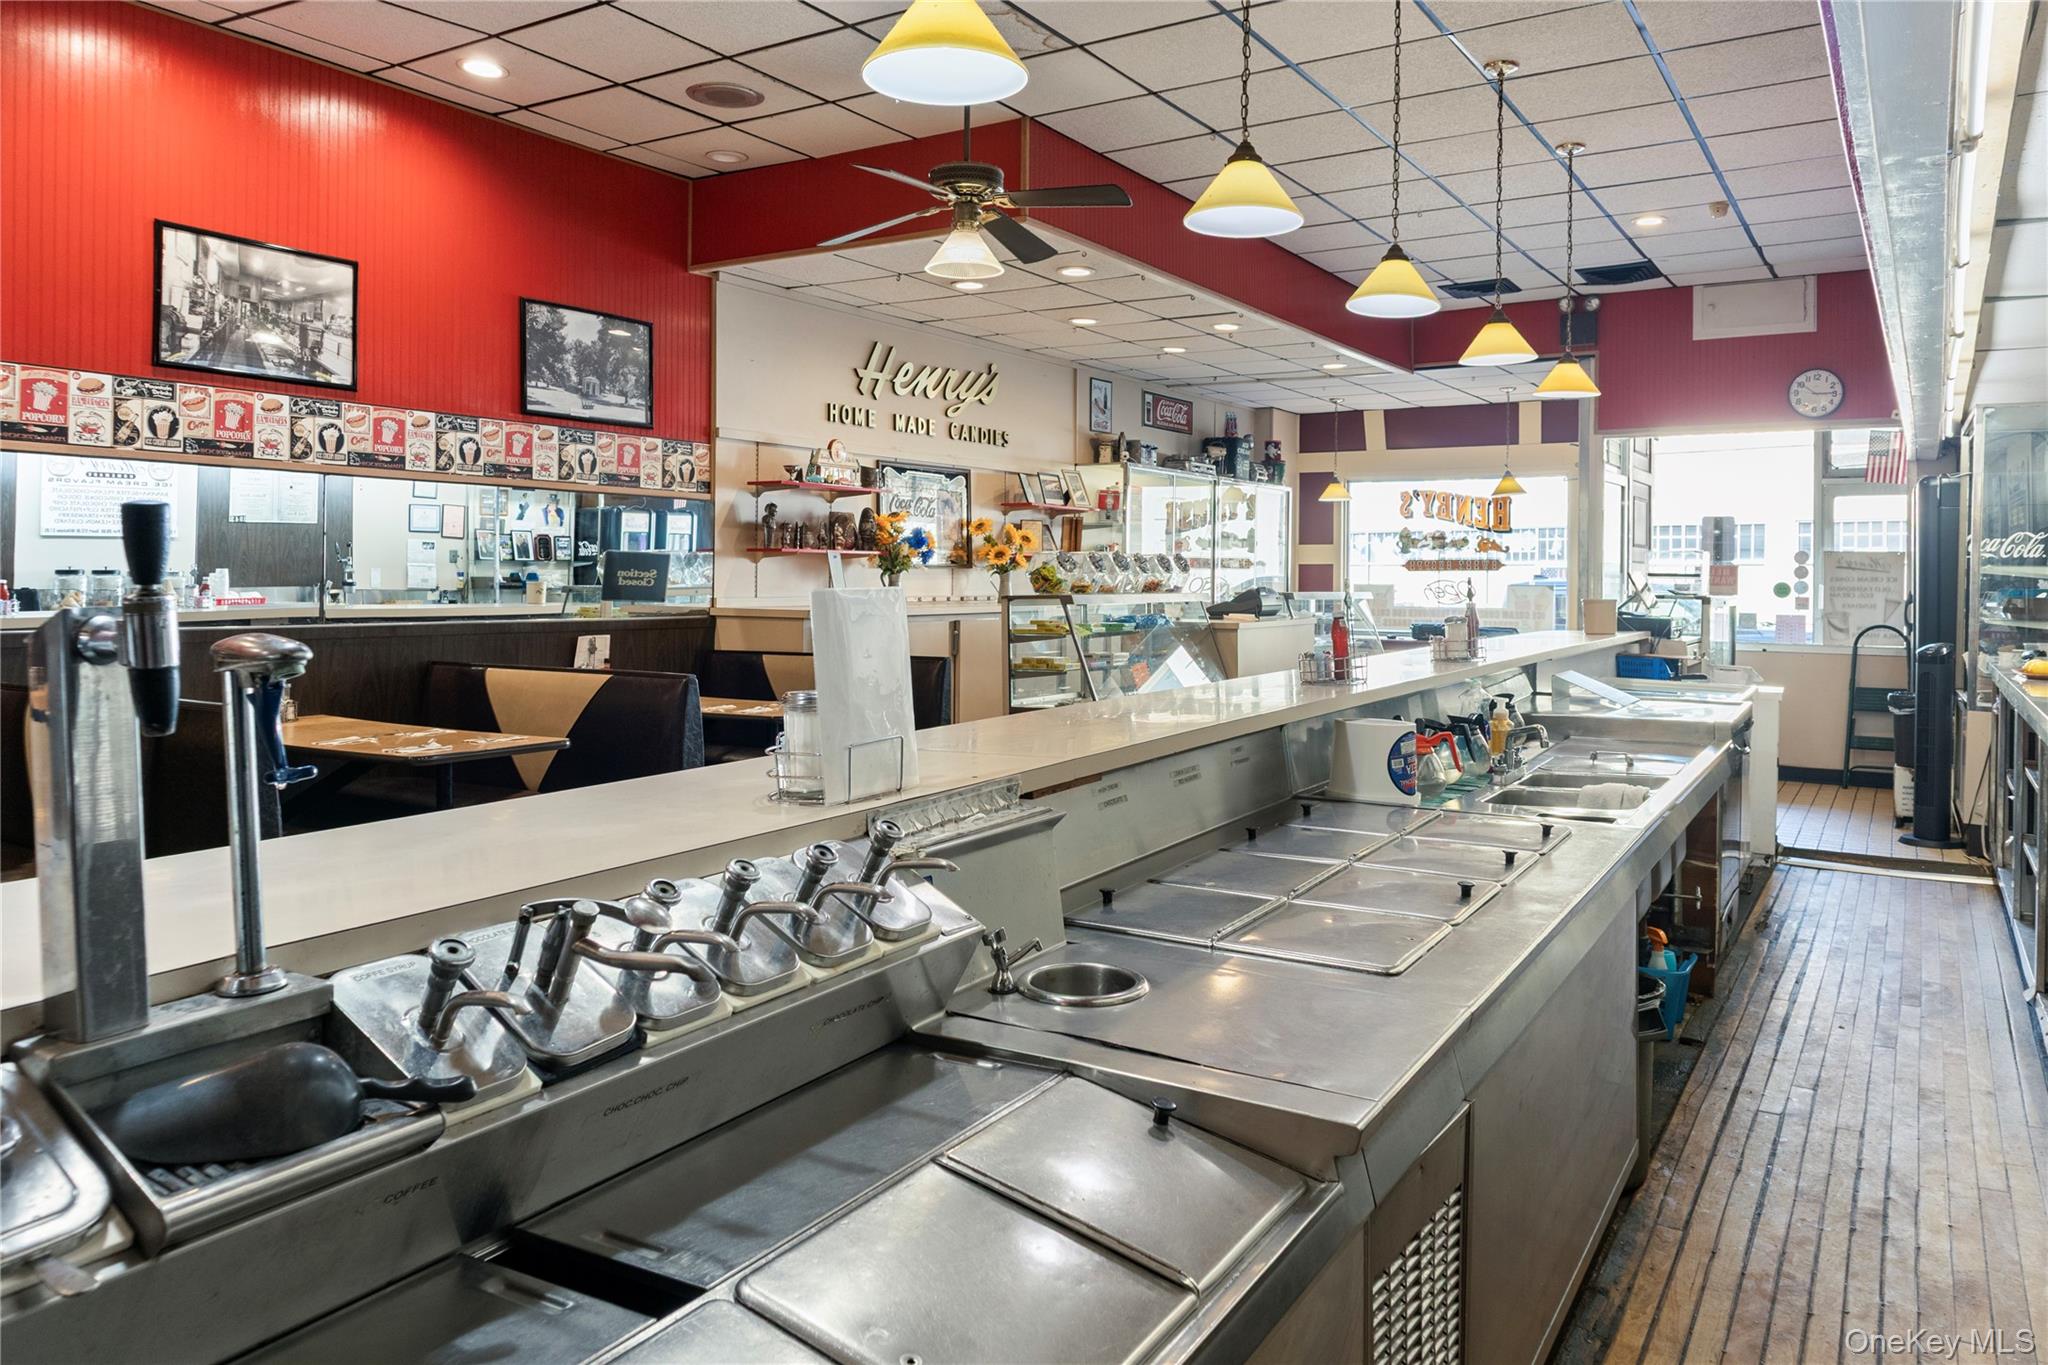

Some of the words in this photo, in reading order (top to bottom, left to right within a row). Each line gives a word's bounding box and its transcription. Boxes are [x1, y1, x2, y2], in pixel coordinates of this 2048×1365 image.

[853, 340, 1001, 419] Henry's
[21, 411, 66, 424] POPCORN
[826, 402, 877, 429] HOME
[892, 413, 937, 437] MADE
[948, 421, 1010, 448] CANDIES
[215, 429, 252, 440] POPCORN
[374, 444, 404, 454] POPCORN
[383, 1176, 439, 1205] COFFEE
